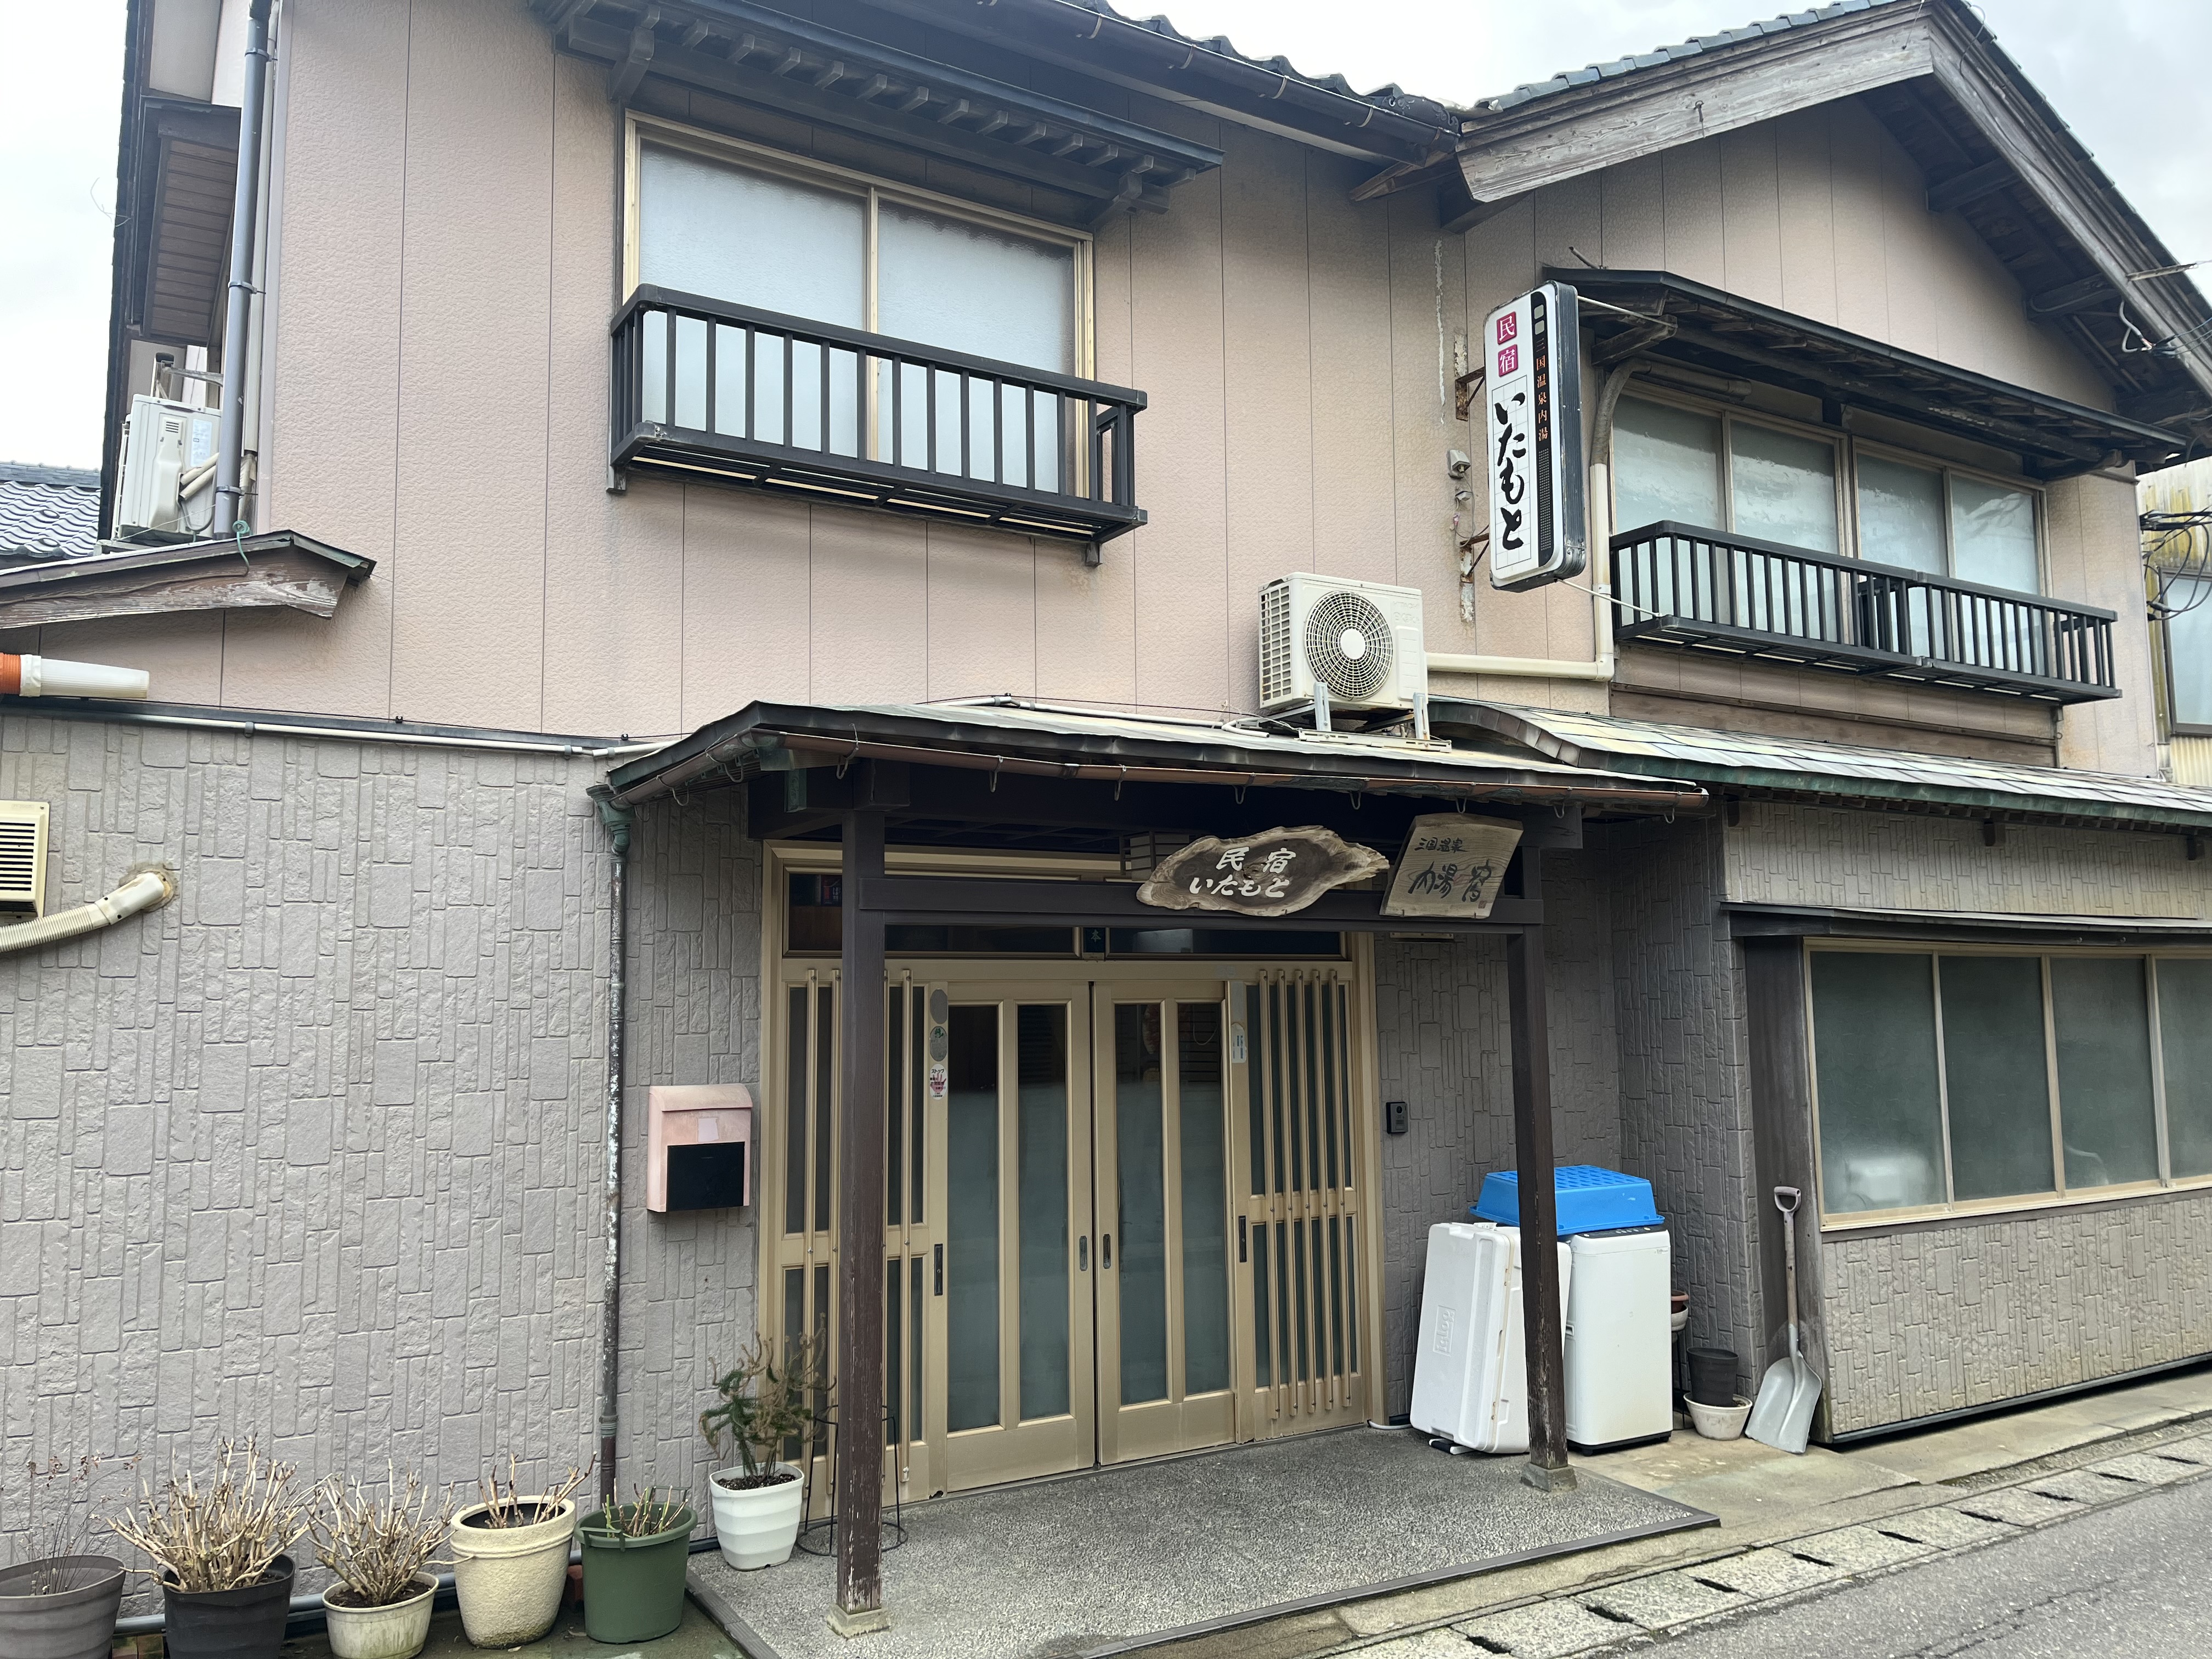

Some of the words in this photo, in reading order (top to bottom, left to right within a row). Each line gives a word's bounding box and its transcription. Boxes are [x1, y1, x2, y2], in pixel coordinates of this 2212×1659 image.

[1498, 314, 1517, 375] 民宿
[1536, 337, 1549, 442] 三国温泉内湯
[1494, 391, 1526, 551] いたもと
[1189, 874, 1290, 898] いたもと
[1215, 846, 1297, 874] 民宿
